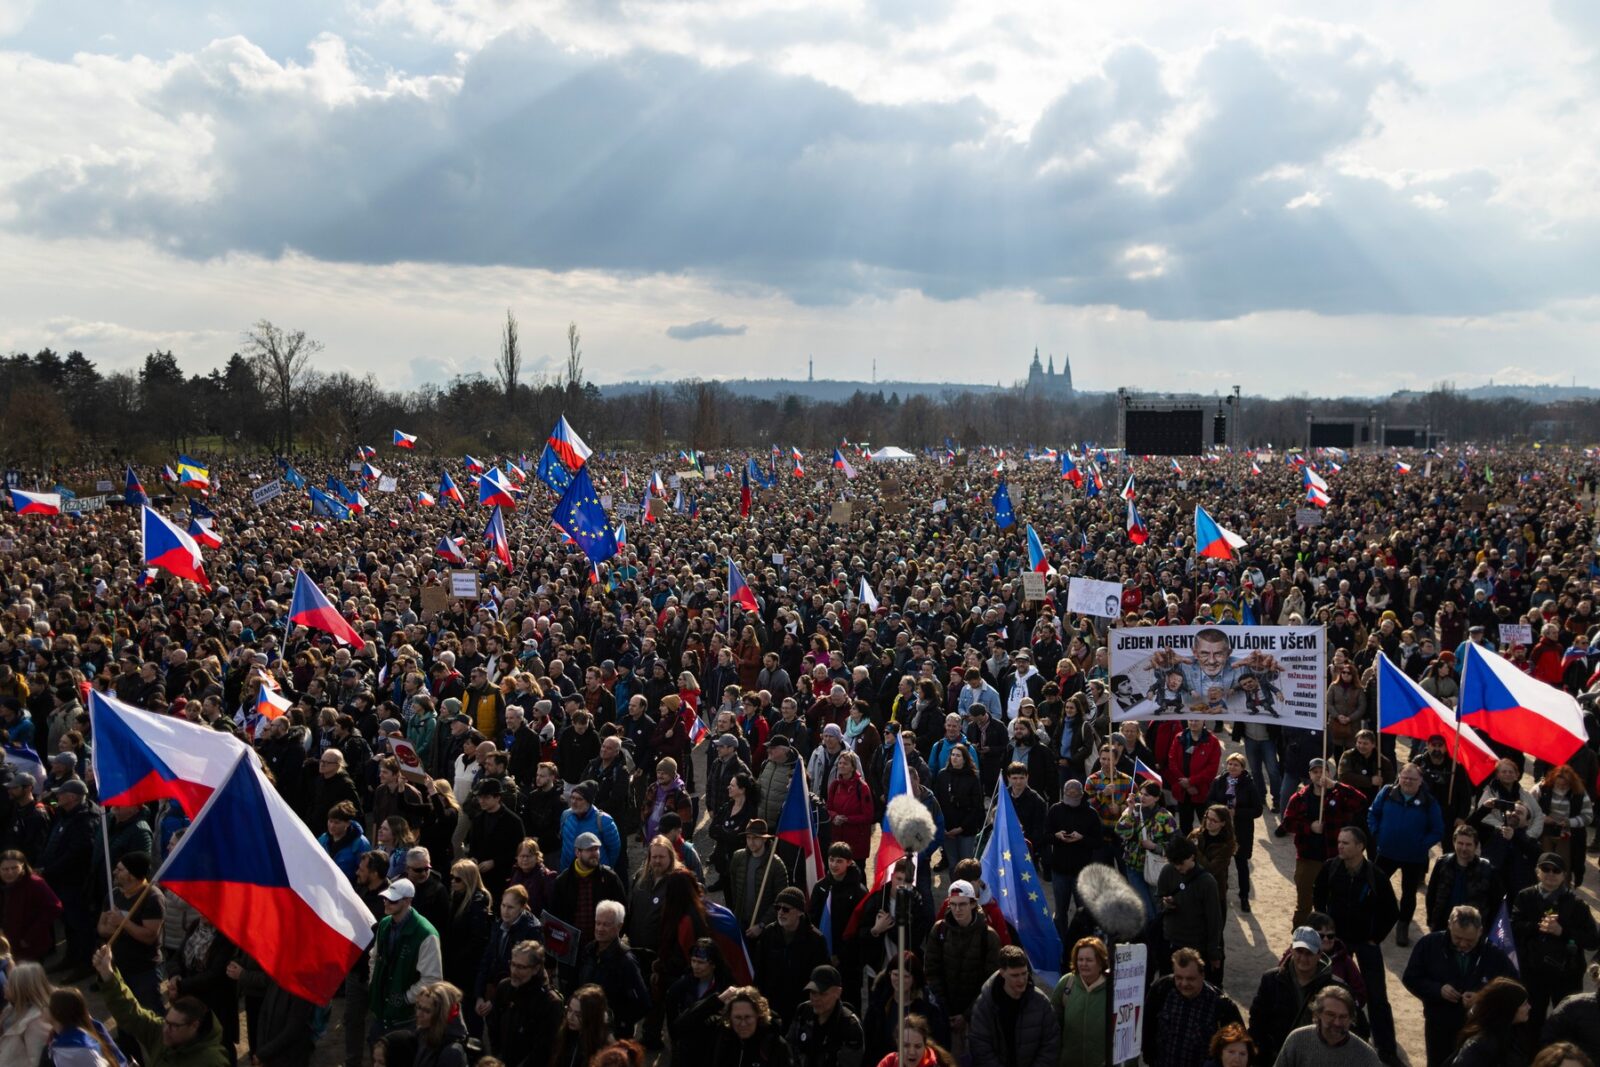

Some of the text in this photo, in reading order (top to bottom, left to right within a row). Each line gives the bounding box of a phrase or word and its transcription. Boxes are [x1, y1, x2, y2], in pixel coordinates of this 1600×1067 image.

[1117, 632, 1317, 651] JEDEN AGENT VLÁDNE VŠEM
[1118, 1002, 1134, 1025] STOP
